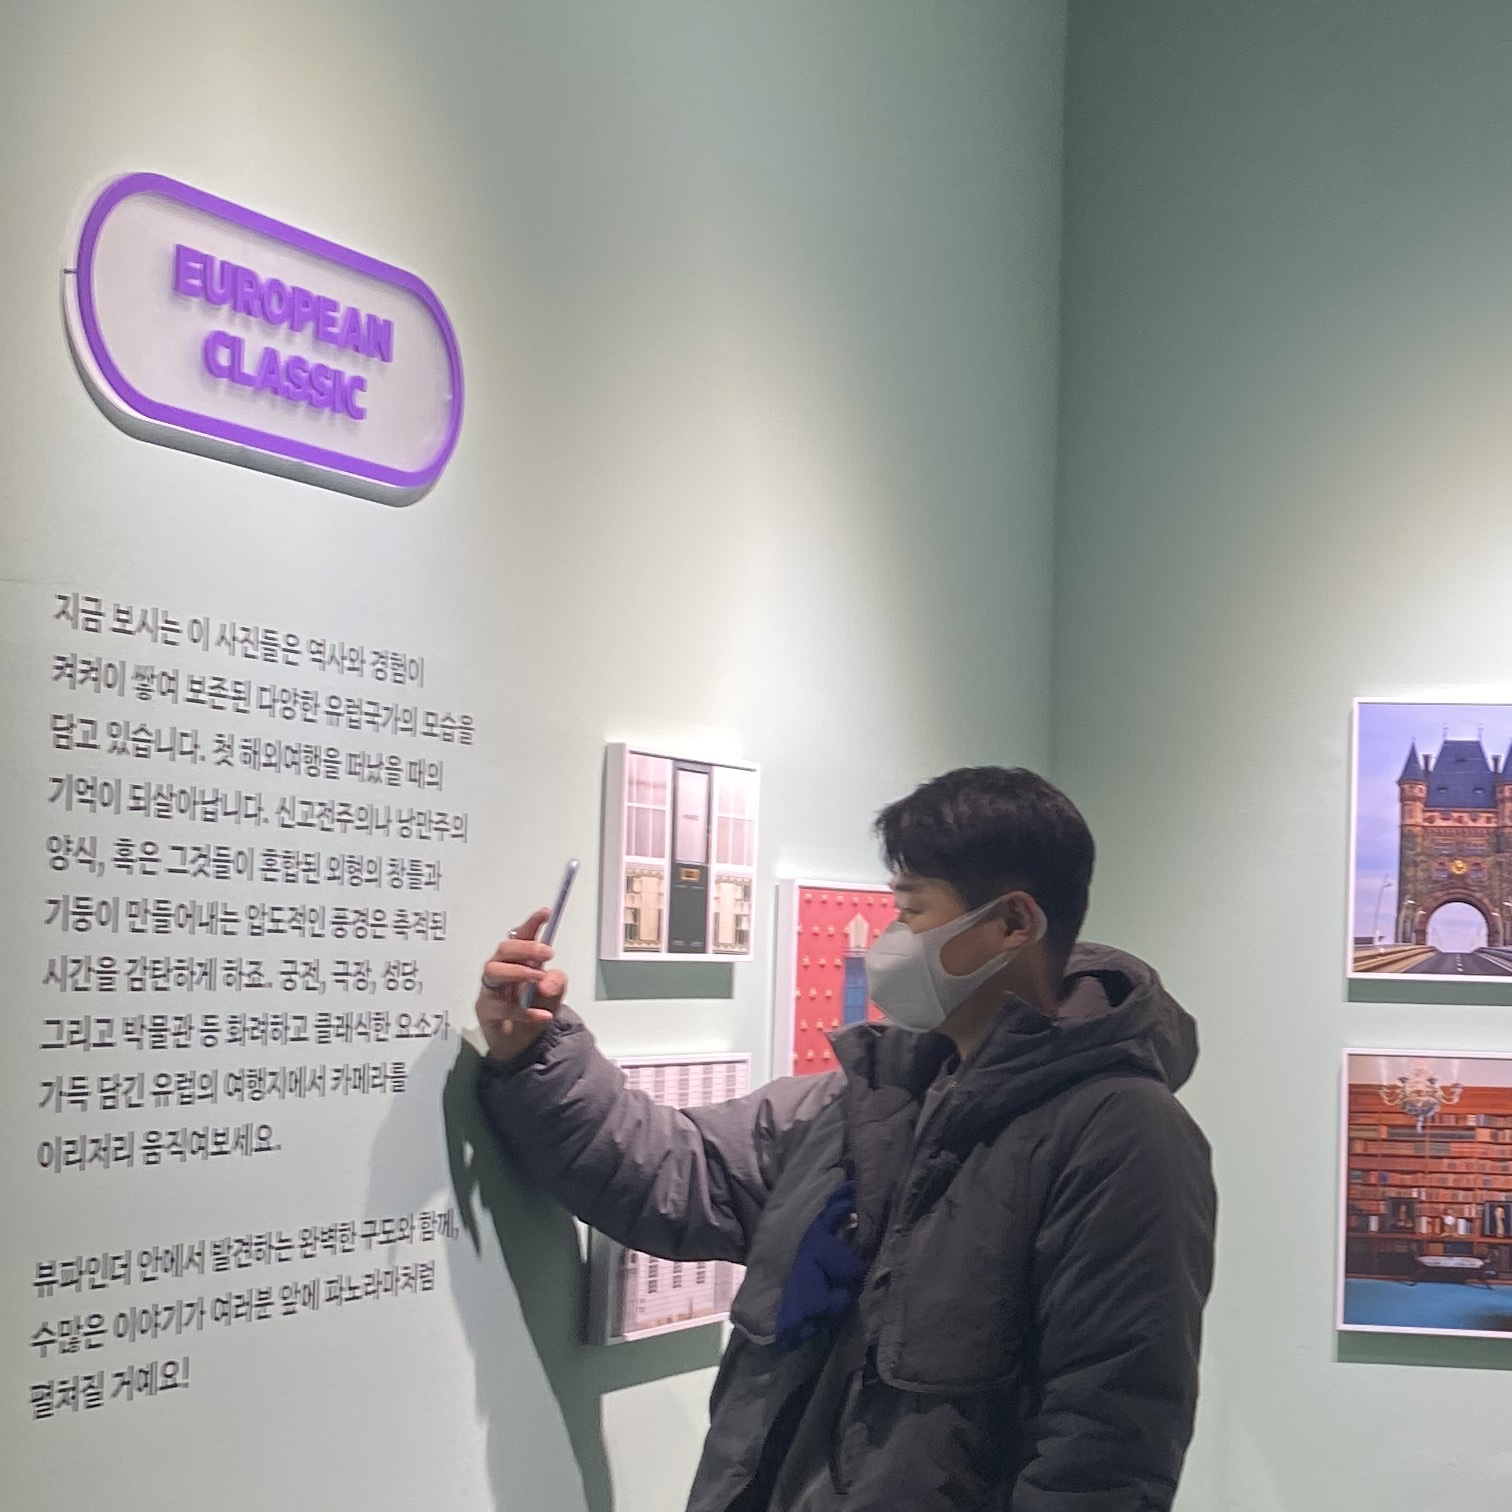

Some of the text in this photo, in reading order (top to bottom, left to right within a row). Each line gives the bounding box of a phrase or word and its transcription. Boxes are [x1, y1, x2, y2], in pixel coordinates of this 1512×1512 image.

[173, 243, 394, 363] EUROPEAN
[203, 330, 367, 421] CLASSIC
[53, 592, 425, 688] 지금 보시는 이 사진들은 역사와 경험이
[51, 653, 475, 746] 켜켜이 쌓여 보존된 다양한 유럽국가의 모습을
[50, 713, 444, 792] 담고 있습니다. 첫 해외여행을 떠났을 때의
[48, 773, 469, 845] 기억이 되살아납니다. 신고전주의나 낭만주의
[46, 834, 443, 891] 양식, 혹은 그것들이 혼합된 외형의 창틀과
[44, 894, 448, 942] 기둥이 만들어내는 압도적인 풍경은 축적된
[41, 954, 424, 996] 시간을 감탄하게 하죠. 궁전, 극장, 성당,
[39, 1009, 451, 1052] 그리고 박물관 등 화려하고 클래식한 요소가
[38, 1061, 408, 1114] 가득 담긴 유럽의 여행지에서 카메라를
[36, 1122, 283, 1174] 이리저리 움직여보세요.
[32, 1207, 461, 1299] 뷰파인더 안에서 발견하는 완벽한 구도와 함께,
[29, 1259, 437, 1359] 수많은 이야기가 여러분 앞에 파노라마처럼
[28, 1356, 191, 1422] 펼쳐질 거예요!
